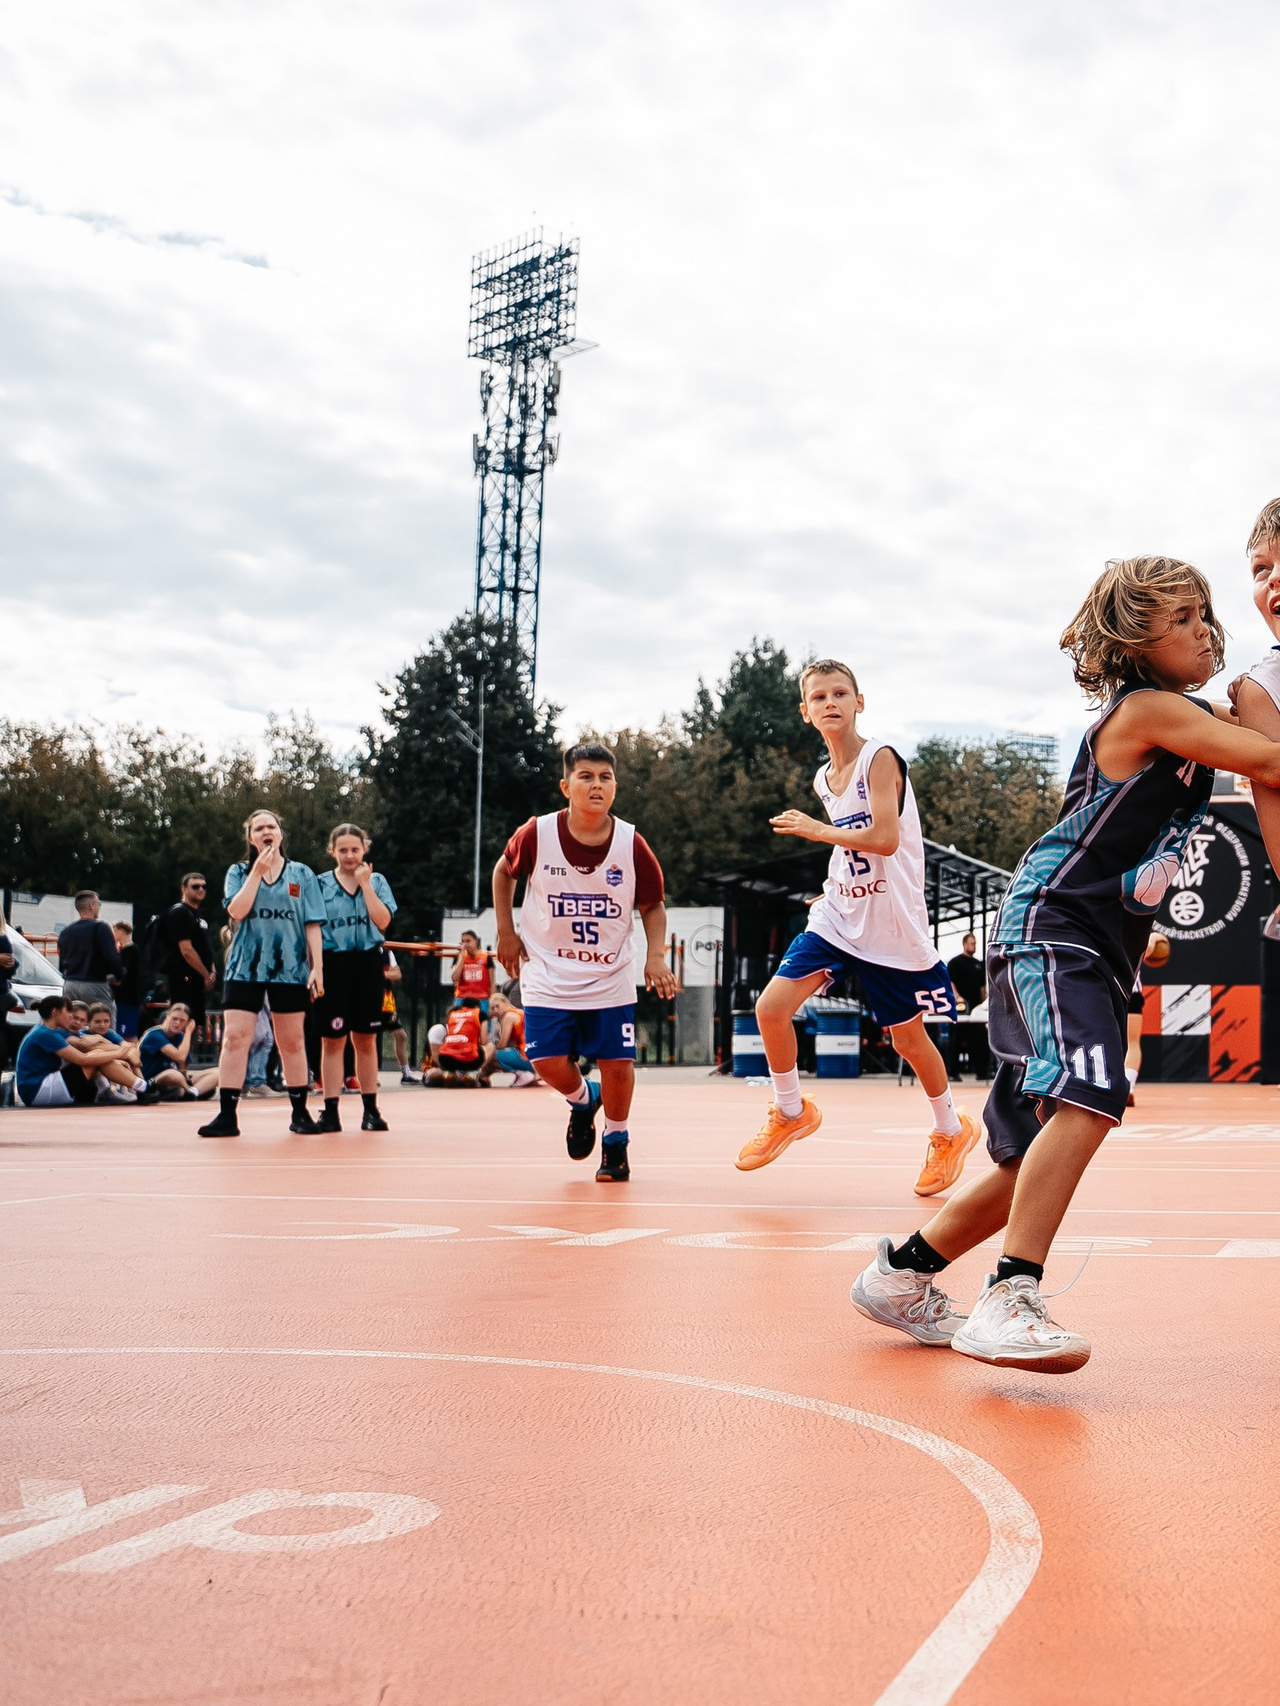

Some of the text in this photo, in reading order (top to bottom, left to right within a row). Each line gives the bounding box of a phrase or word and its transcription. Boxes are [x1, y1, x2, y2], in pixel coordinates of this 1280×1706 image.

[550, 866, 568, 877] ВТБ
[260, 908, 296, 921] DKC
[549, 896, 622, 918] ТВЕРЬ
[572, 921, 599, 945] 95
[578, 951, 617, 965] DKC
[915, 987, 953, 1014] 55
[621, 1022, 637, 1048] 9
[1071, 1044, 1111, 1090] 11
